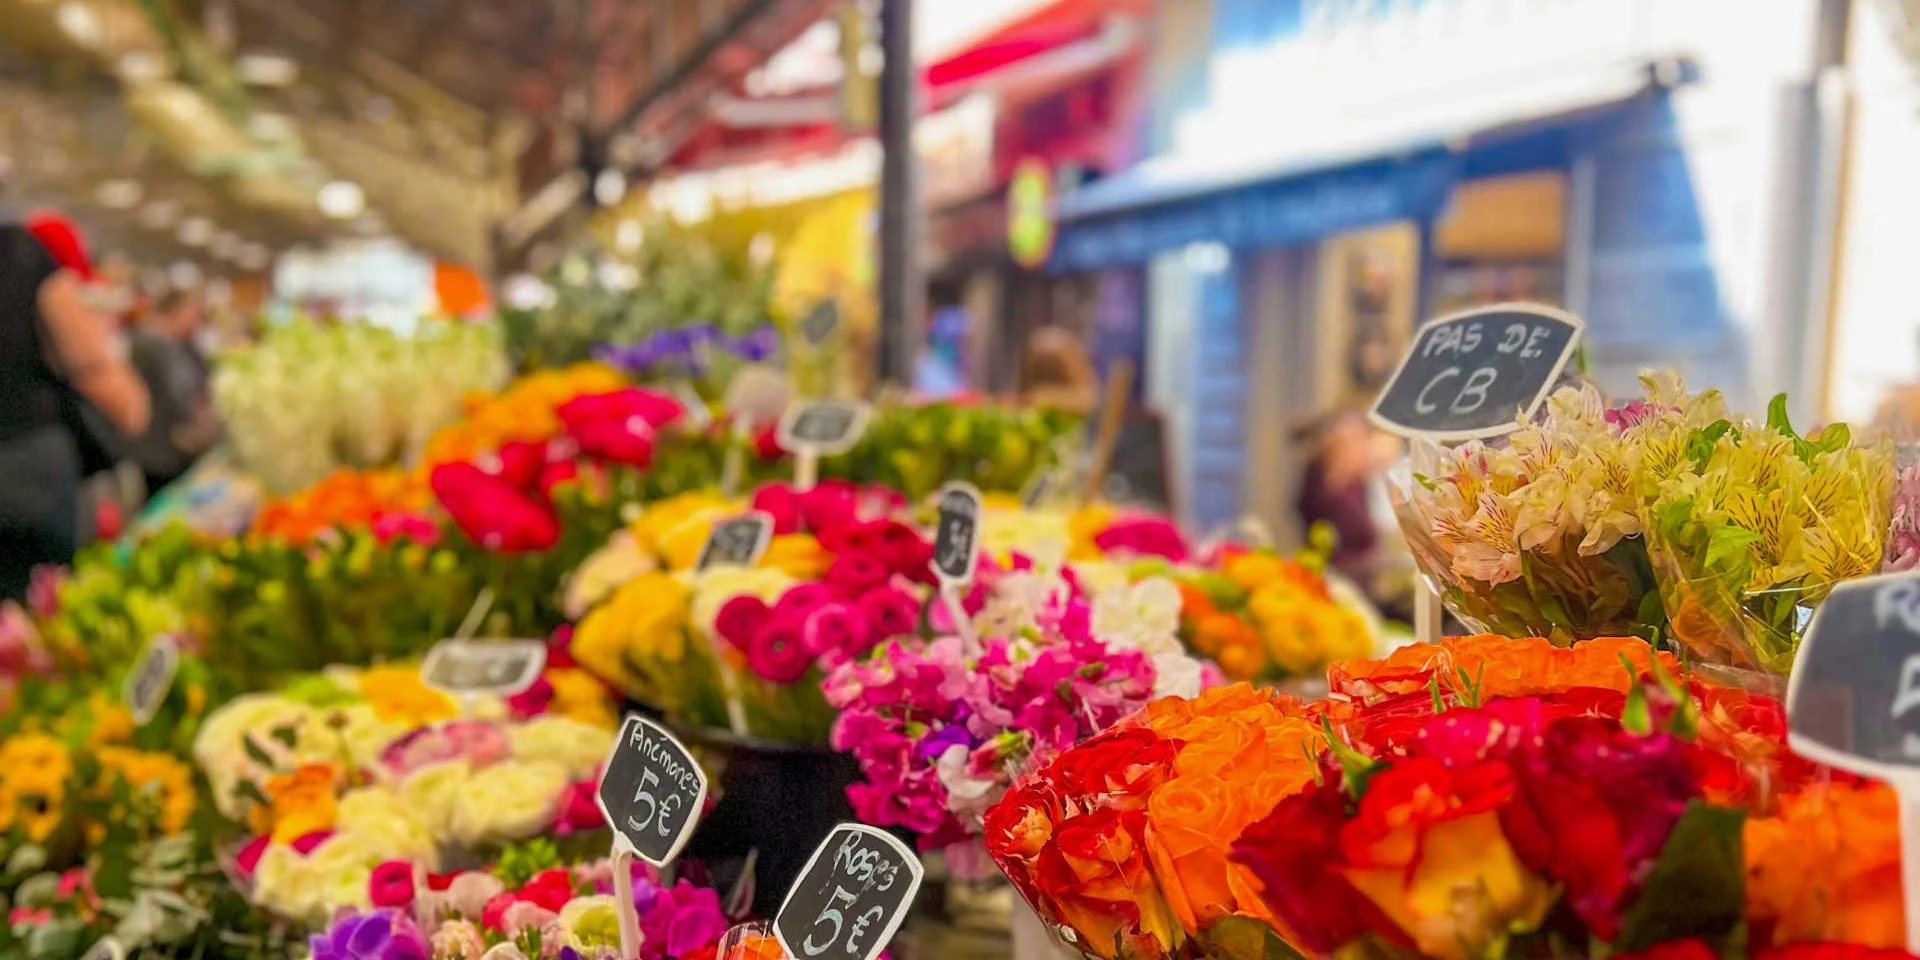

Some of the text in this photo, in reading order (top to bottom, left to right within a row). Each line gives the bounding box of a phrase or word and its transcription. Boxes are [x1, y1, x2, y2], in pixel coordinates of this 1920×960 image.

[1422, 323, 1551, 359] PAS DE
[1414, 366, 1498, 414] CB
[629, 722, 699, 796] Anémones
[627, 766, 682, 837] 5€
[822, 831, 898, 893] Roses
[803, 885, 884, 956] 5€
